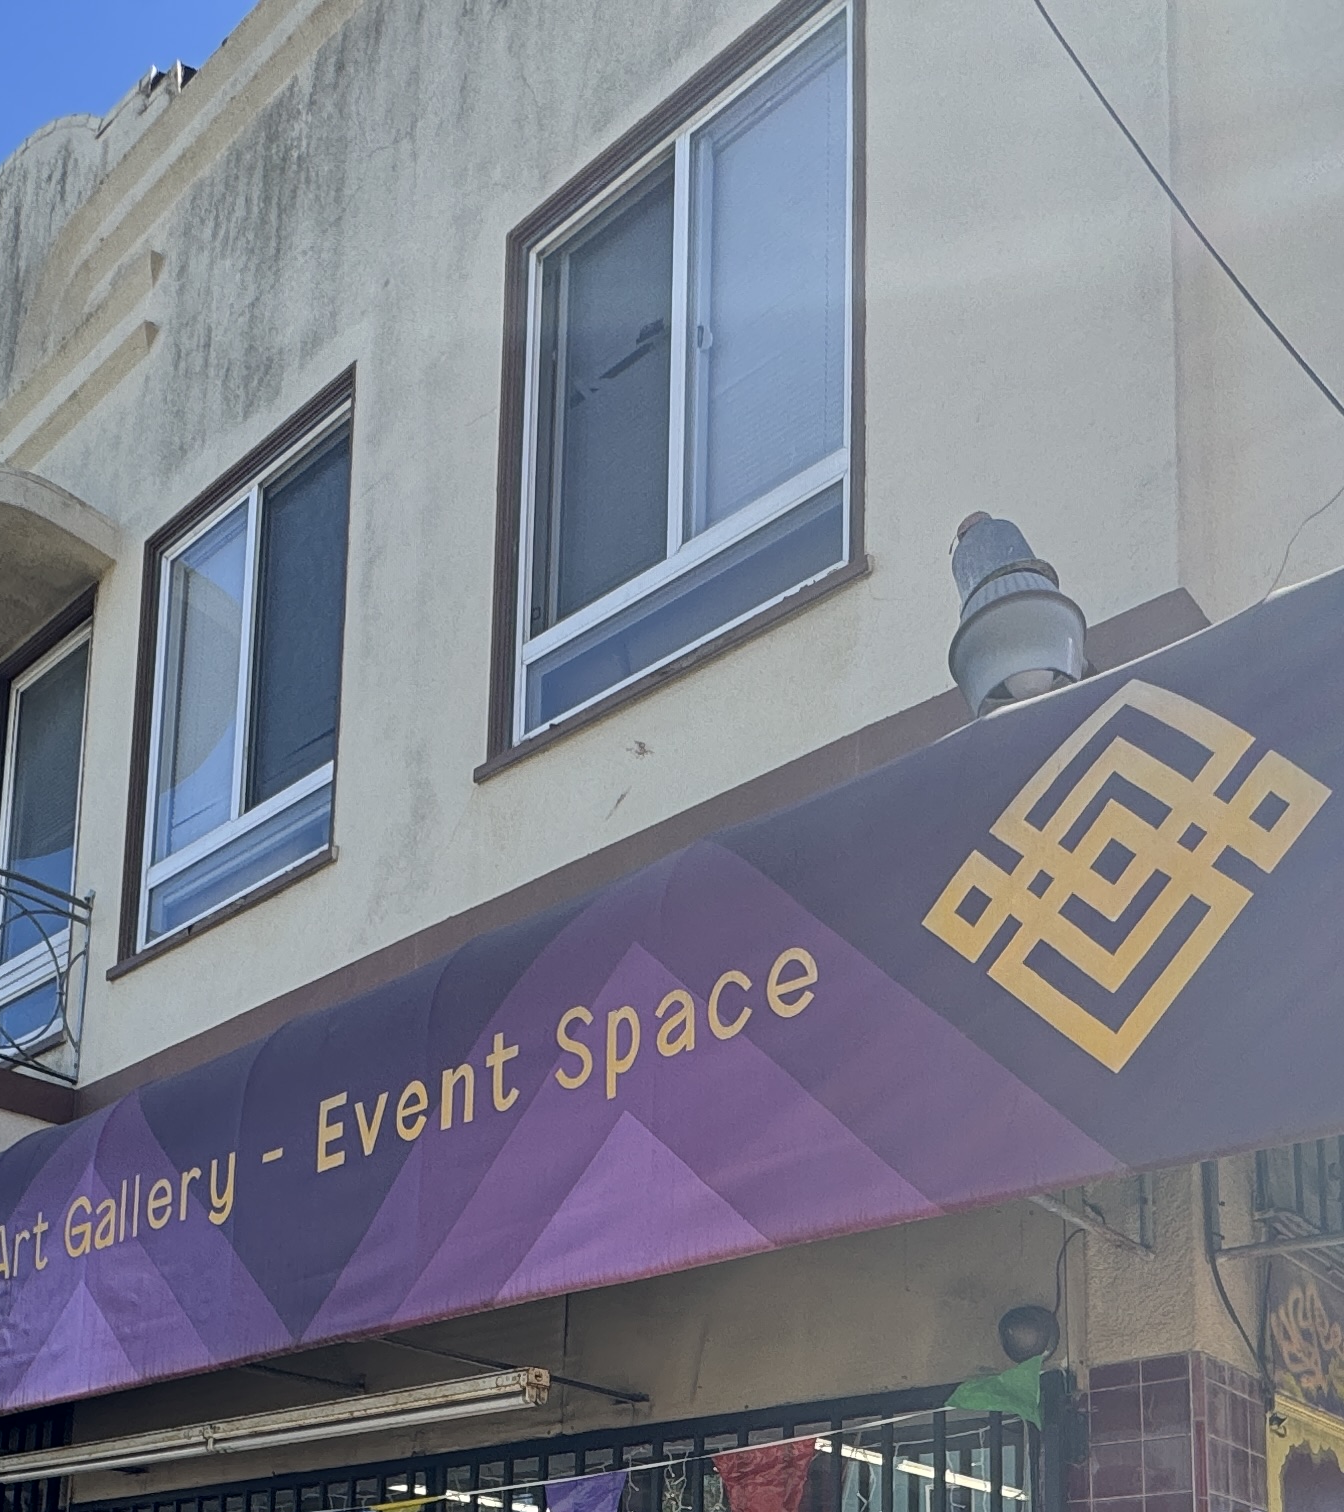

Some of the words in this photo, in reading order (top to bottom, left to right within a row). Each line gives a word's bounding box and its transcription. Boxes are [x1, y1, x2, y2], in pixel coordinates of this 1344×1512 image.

[64, 1150, 238, 1257] Gallery
[316, 1031, 522, 1174] Event
[555, 945, 820, 1101] Space
